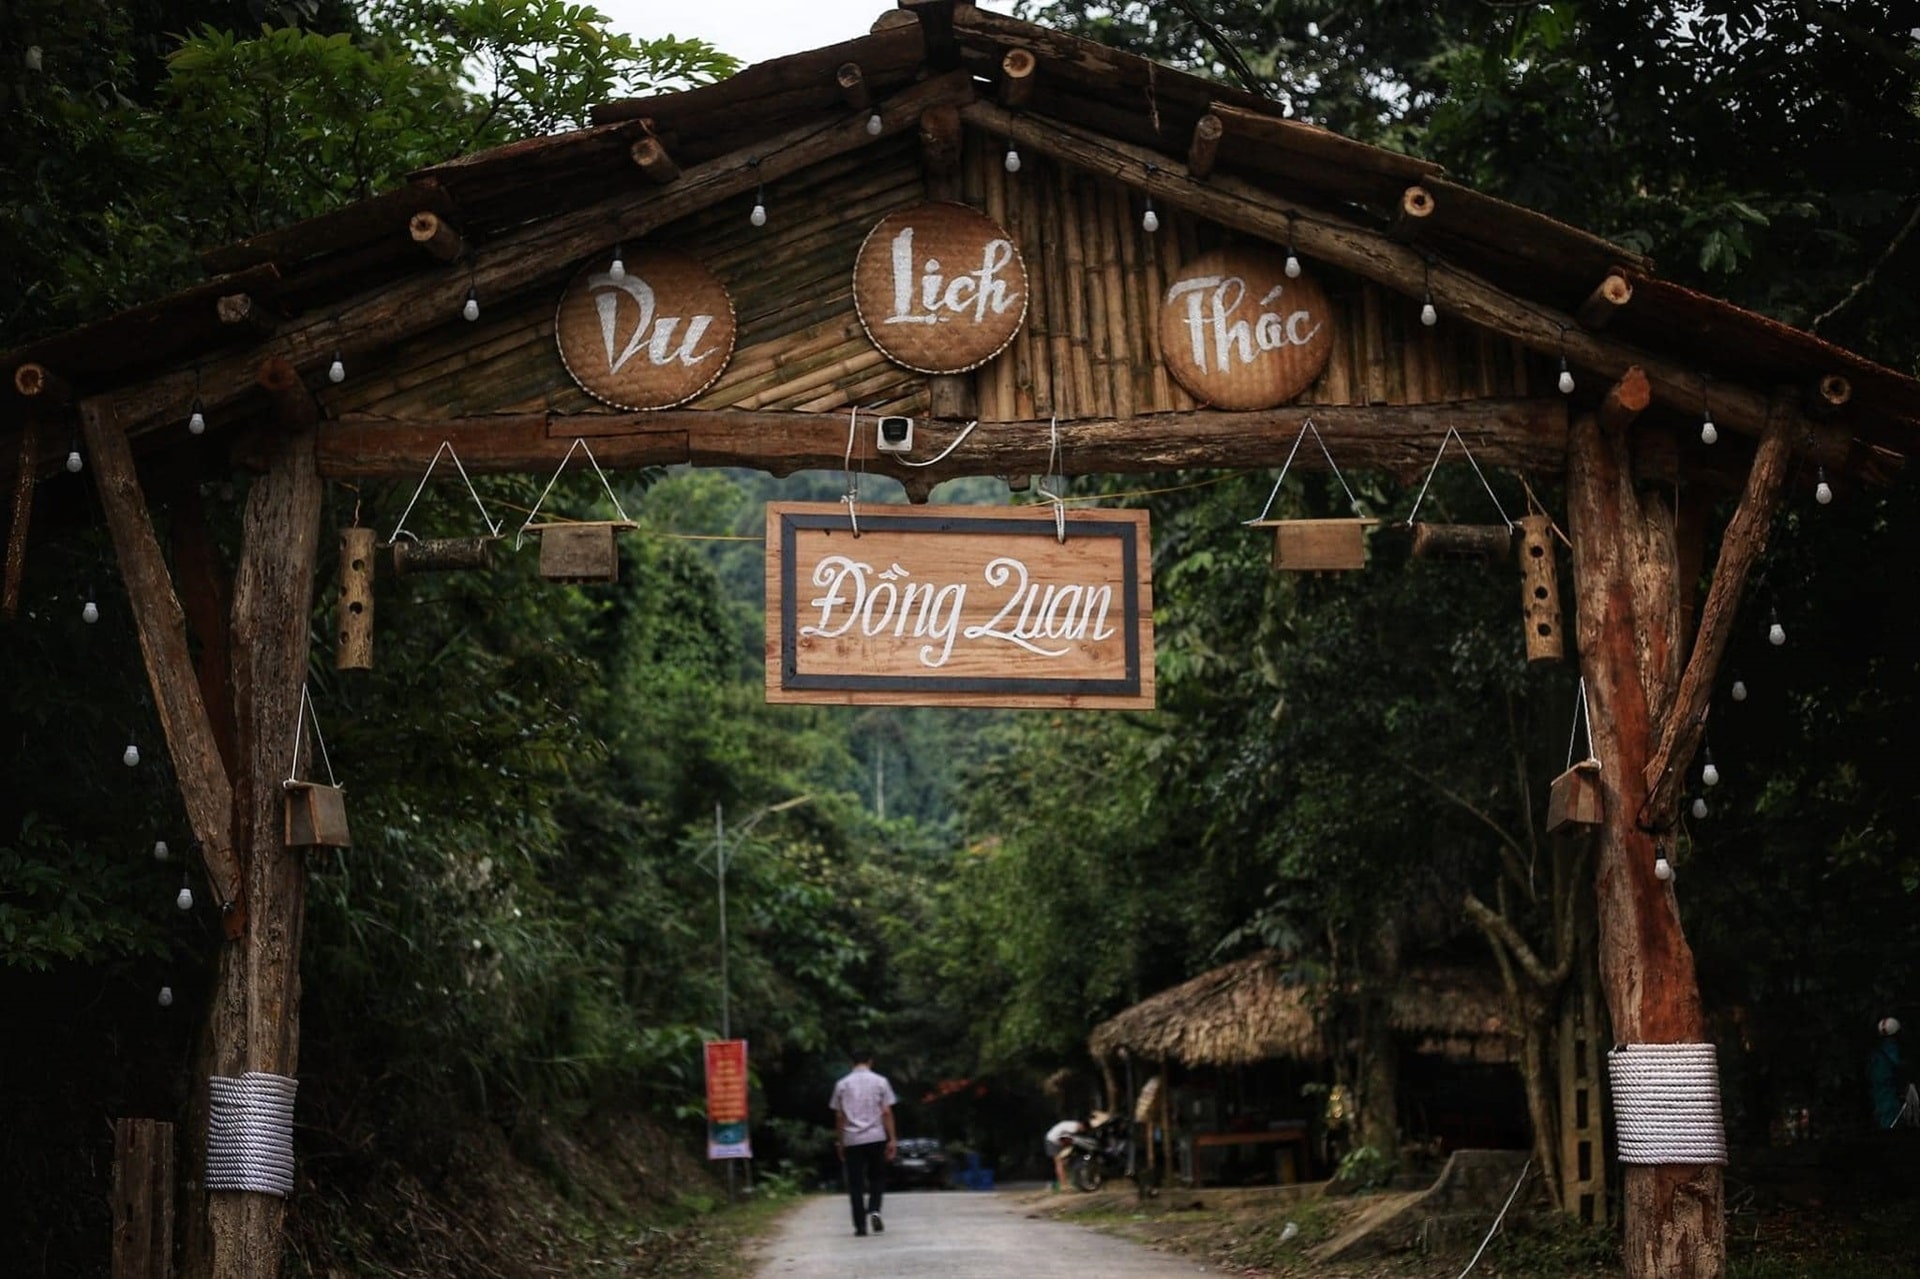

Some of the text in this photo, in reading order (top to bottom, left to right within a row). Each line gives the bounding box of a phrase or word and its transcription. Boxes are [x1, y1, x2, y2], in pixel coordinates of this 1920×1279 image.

[588, 273, 719, 375] Du
[883, 227, 1019, 325] Lịch
[1167, 275, 1322, 376] Thác
[800, 555, 1116, 668] Đồng Quan
